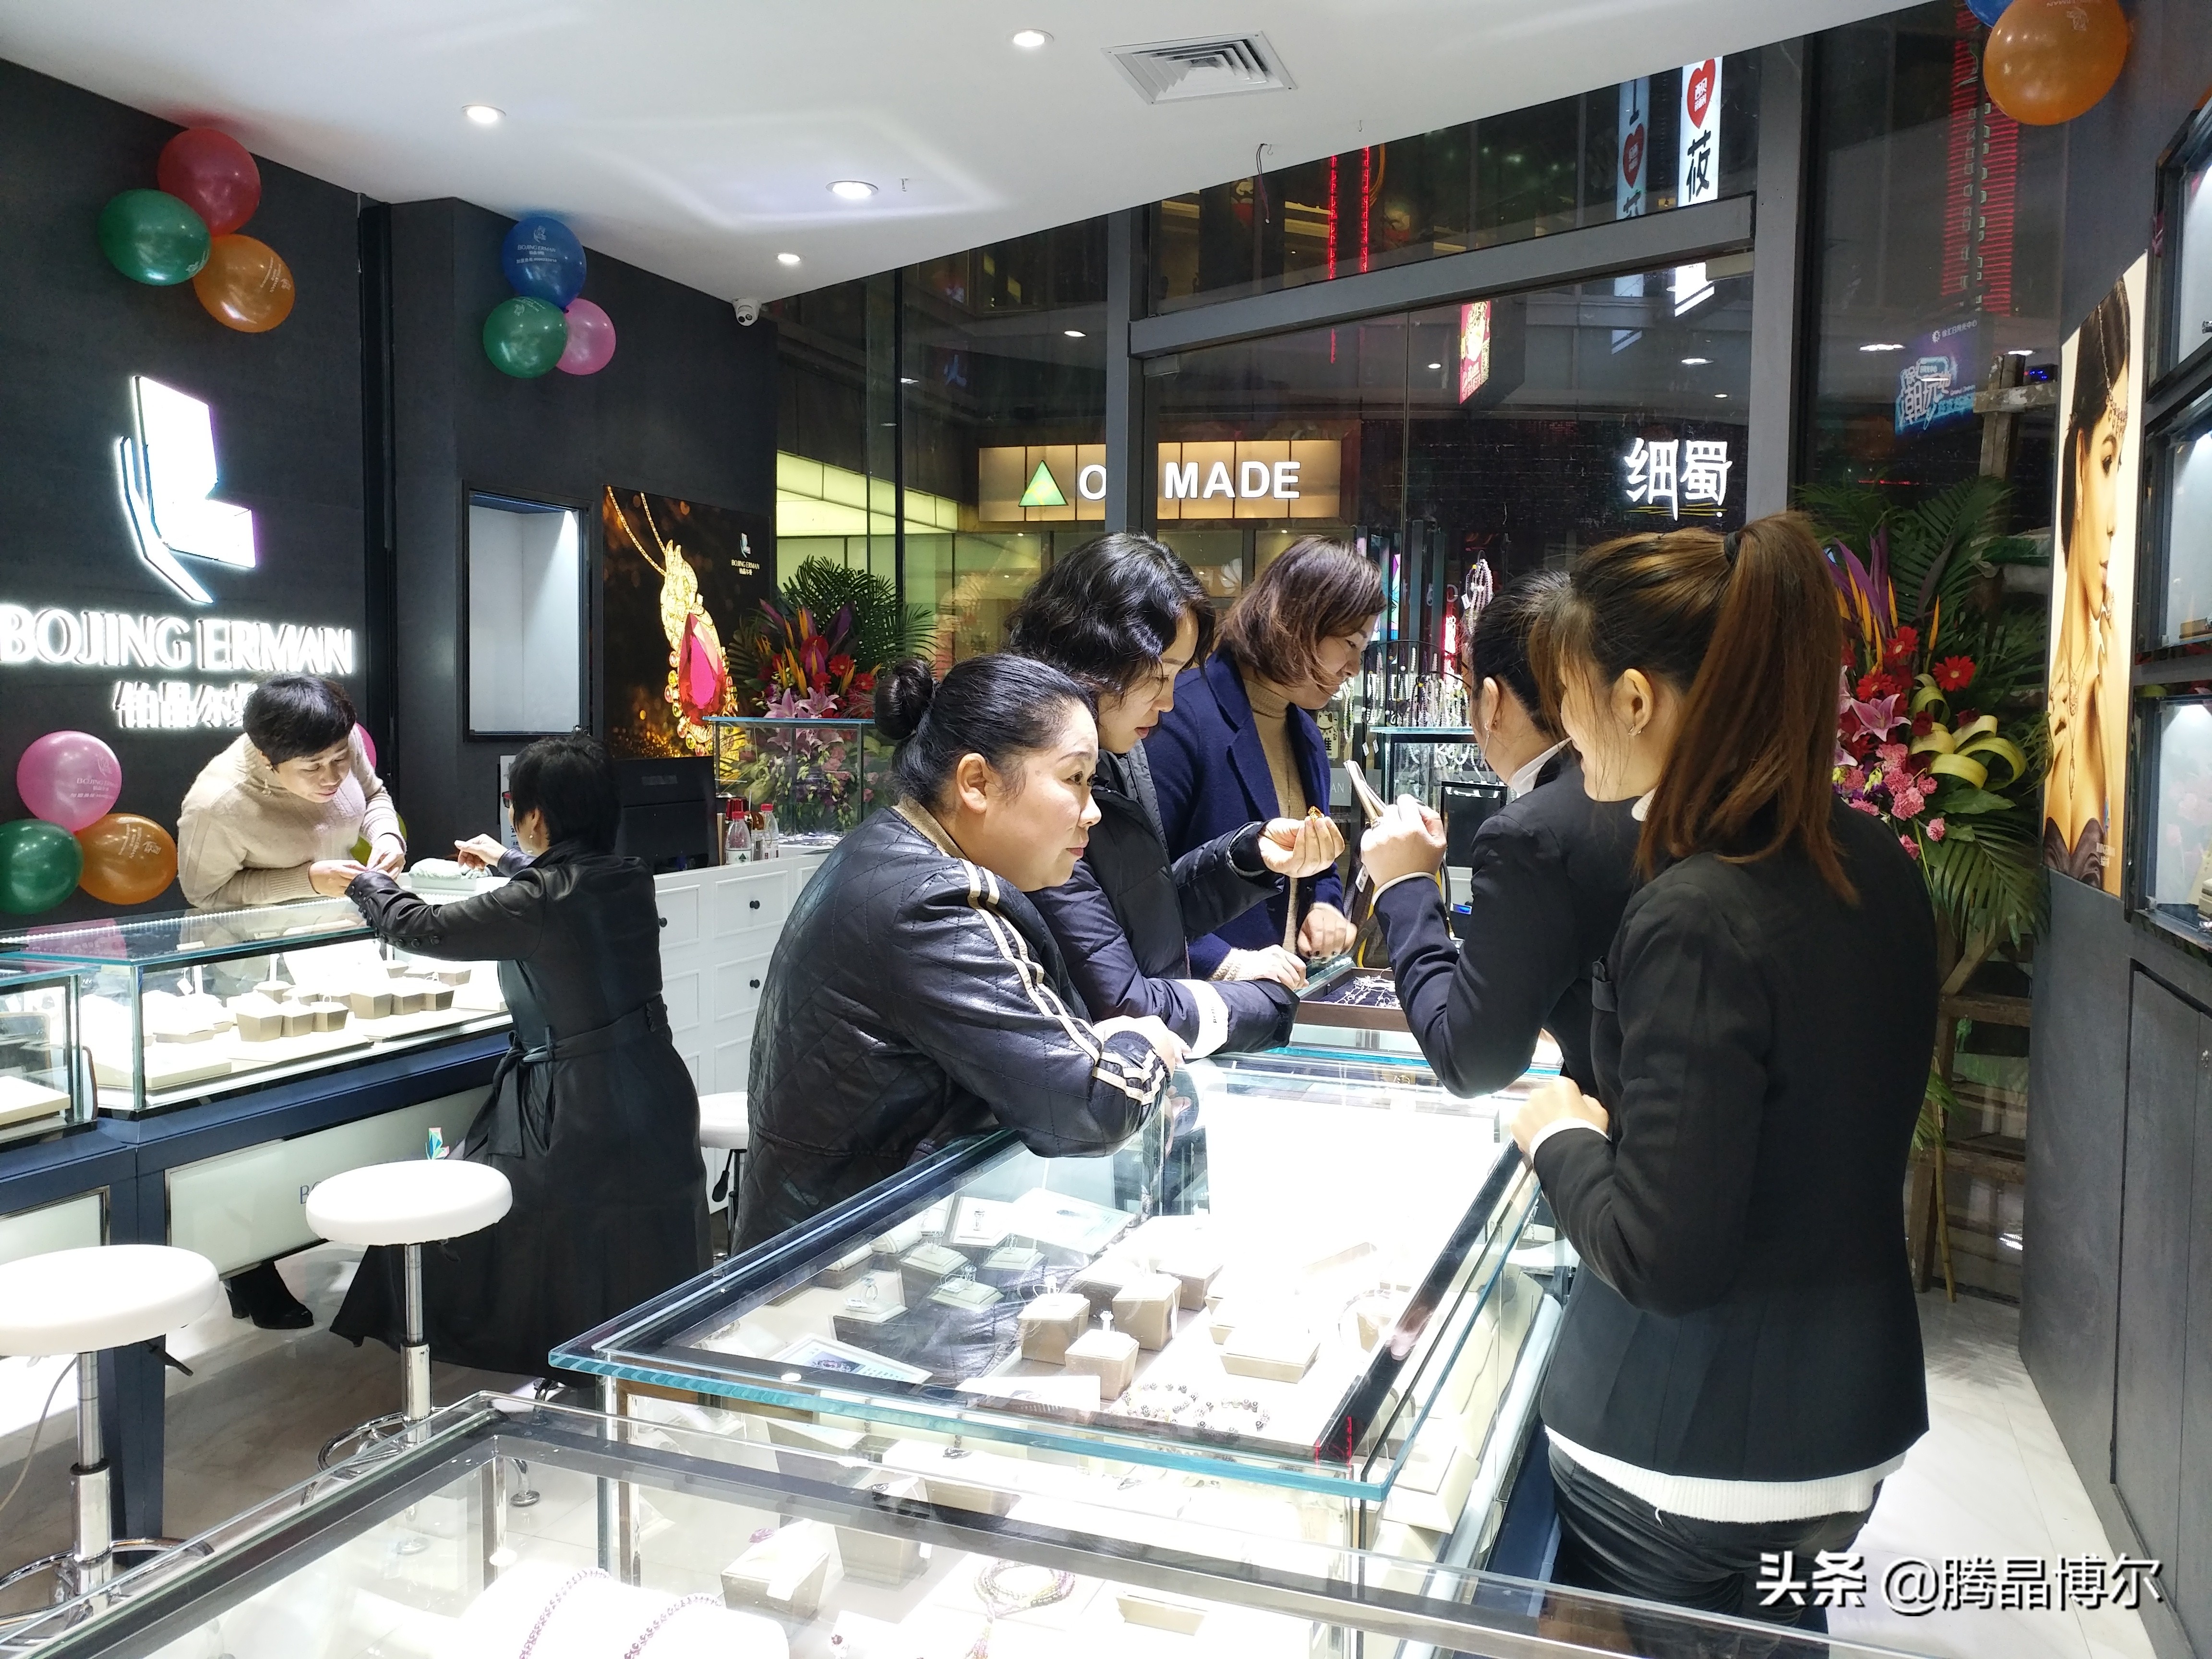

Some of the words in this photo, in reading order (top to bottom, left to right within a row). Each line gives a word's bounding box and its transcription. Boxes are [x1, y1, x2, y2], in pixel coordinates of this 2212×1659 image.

[1165, 461, 1301, 500] MADE
[1624, 437, 1732, 521] 细蜀
[731, 559, 745, 567] BOJING
[746, 562, 760, 570] ERMAN
[0, 604, 192, 669] BOJING
[195, 619, 353, 674] ERMAN
